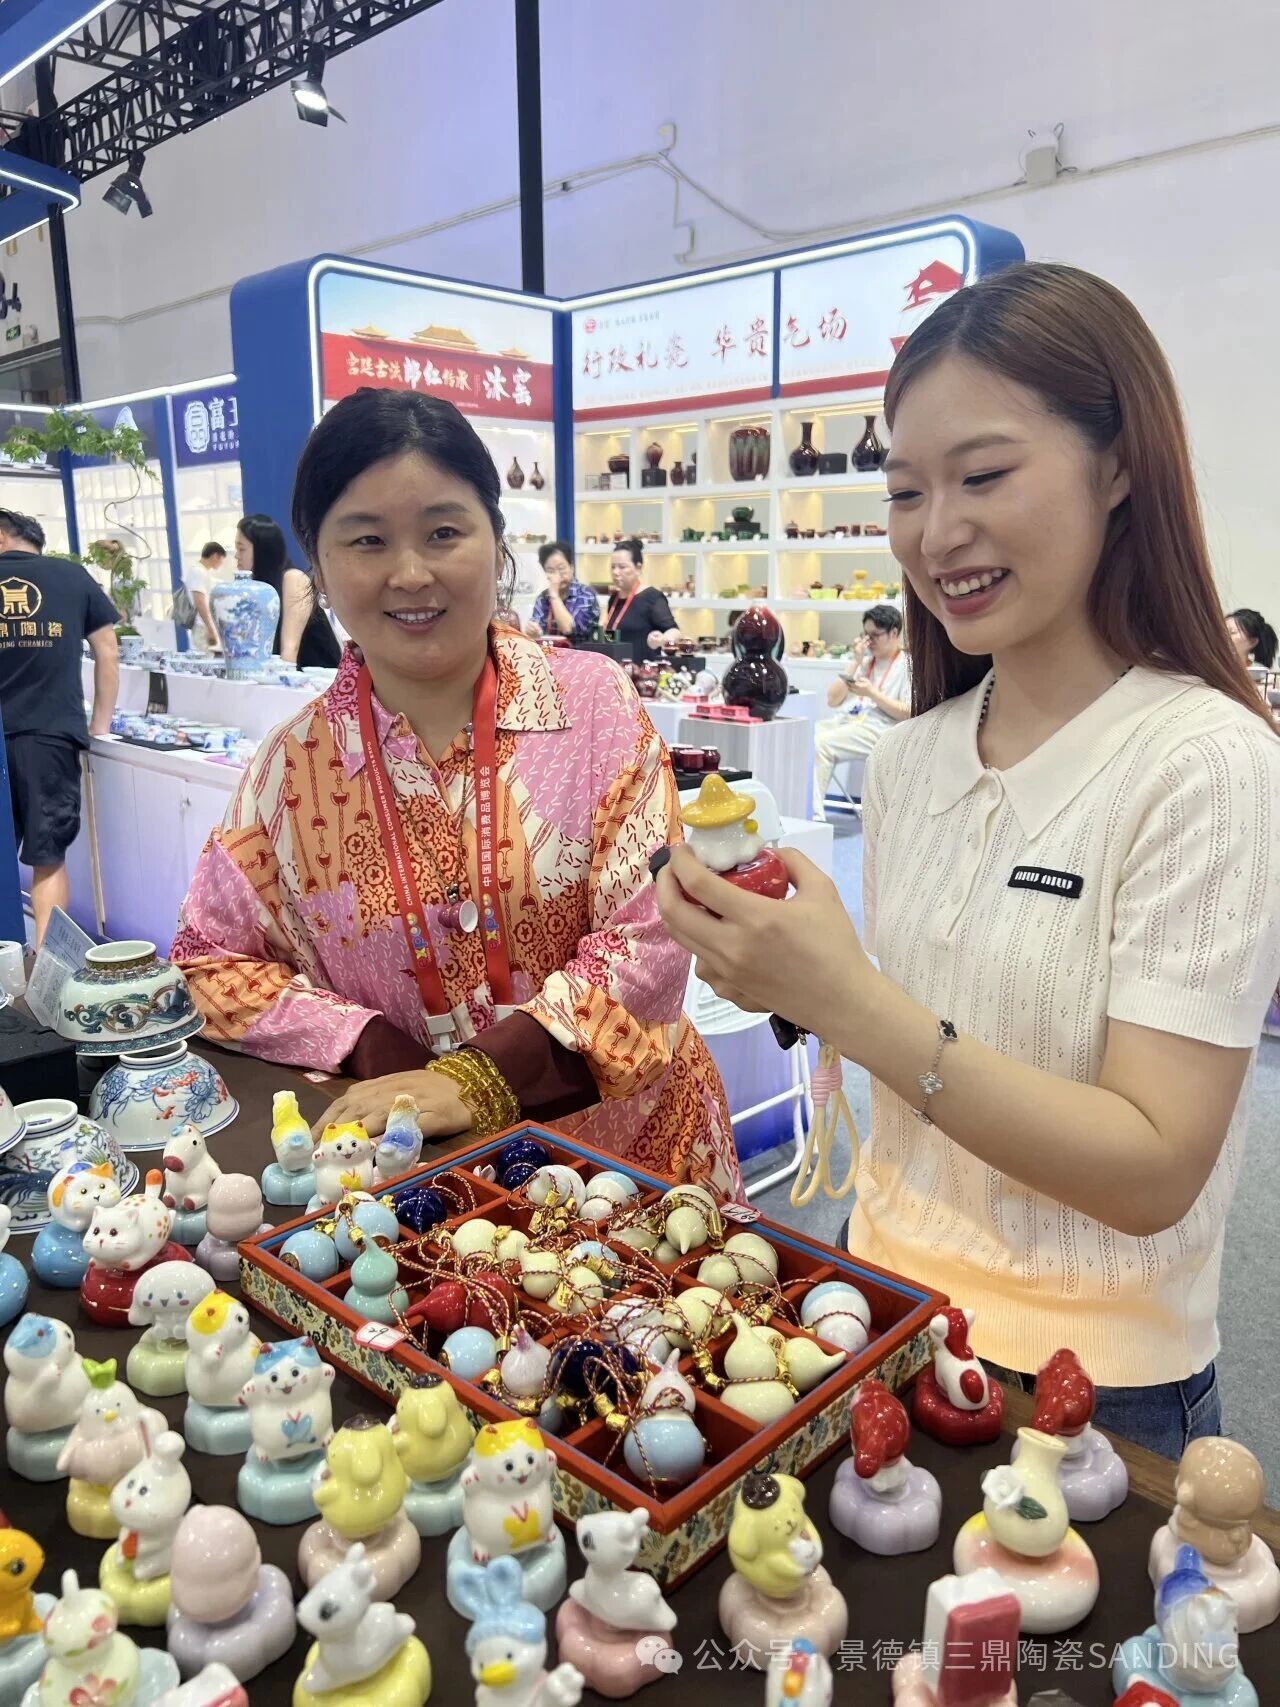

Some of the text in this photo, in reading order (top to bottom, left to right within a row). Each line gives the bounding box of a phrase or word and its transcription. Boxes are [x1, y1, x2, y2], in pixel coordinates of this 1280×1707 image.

[18, 640, 53, 648] CERAMICS
[366, 741, 414, 906] CHINA INTERNATIONAL CONSUMER PRODUCTS EXPO
[479, 766, 493, 887] 中国国际消费品博览会
[367, 1327, 390, 1345] 29
